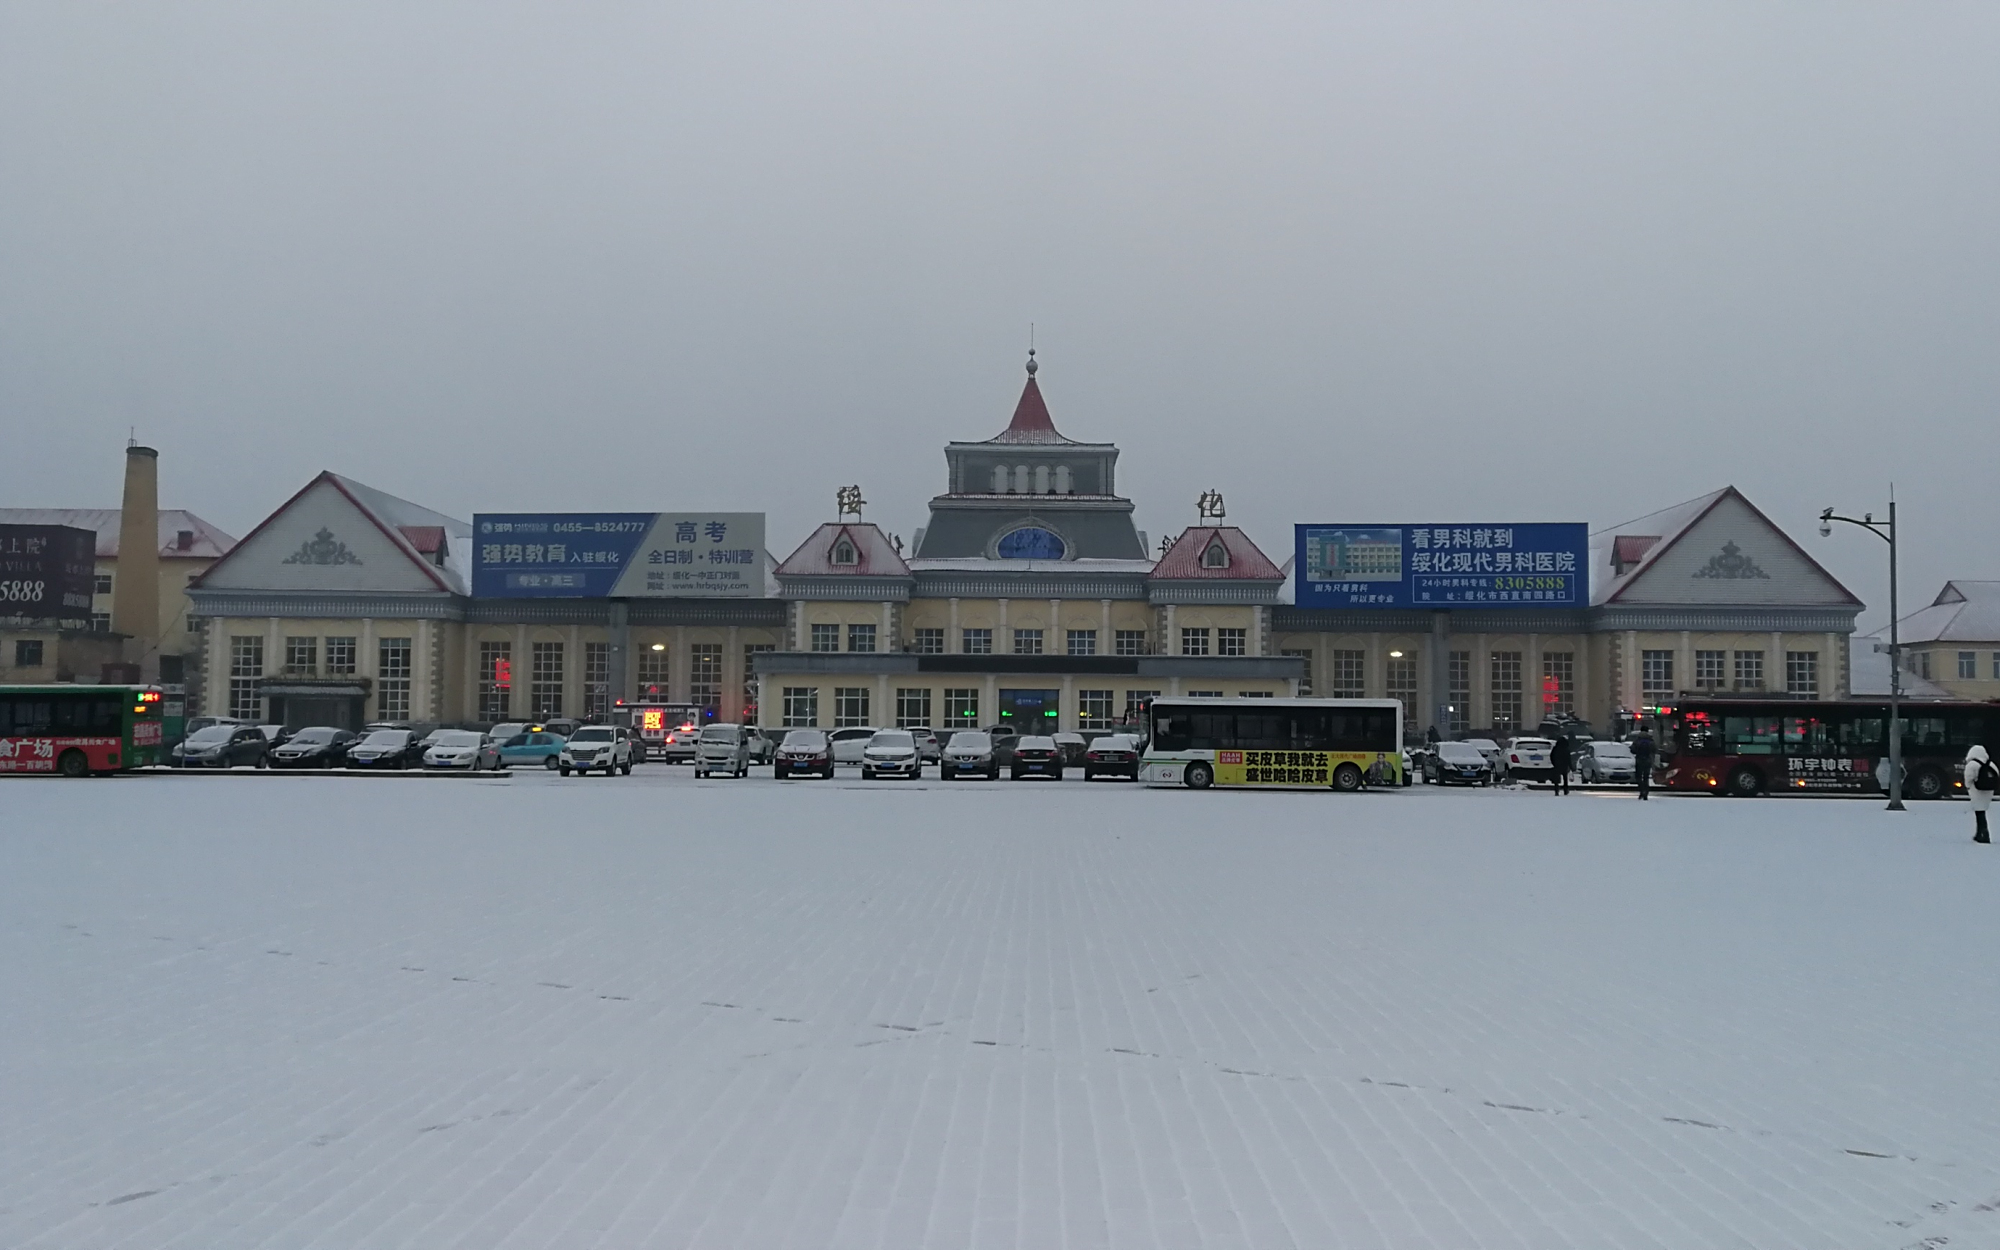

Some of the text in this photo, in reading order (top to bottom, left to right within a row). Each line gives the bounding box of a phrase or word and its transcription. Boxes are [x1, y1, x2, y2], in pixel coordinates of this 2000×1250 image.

[674, 521, 727, 543] 高考
[1411, 528, 1513, 549] 看男科就到
[0, 537, 42, 555] 上院
[482, 544, 619, 563] 强势教育 入驻绥化
[648, 549, 754, 565] 全日制·特训营
[1411, 551, 1576, 573] 绥化现代男科医院
[0, 580, 45, 602] 5888
[1314, 583, 1368, 593] 因为只看男科
[1495, 576, 1565, 590] 8305888
[1349, 594, 1394, 604] 所以更专业
[0, 738, 53, 758] 食广场
[1246, 752, 1329, 767] 买皮草我就去
[1788, 757, 1853, 772] 环宇钟表
[1246, 768, 1329, 783] 盛世哈哈皮草
